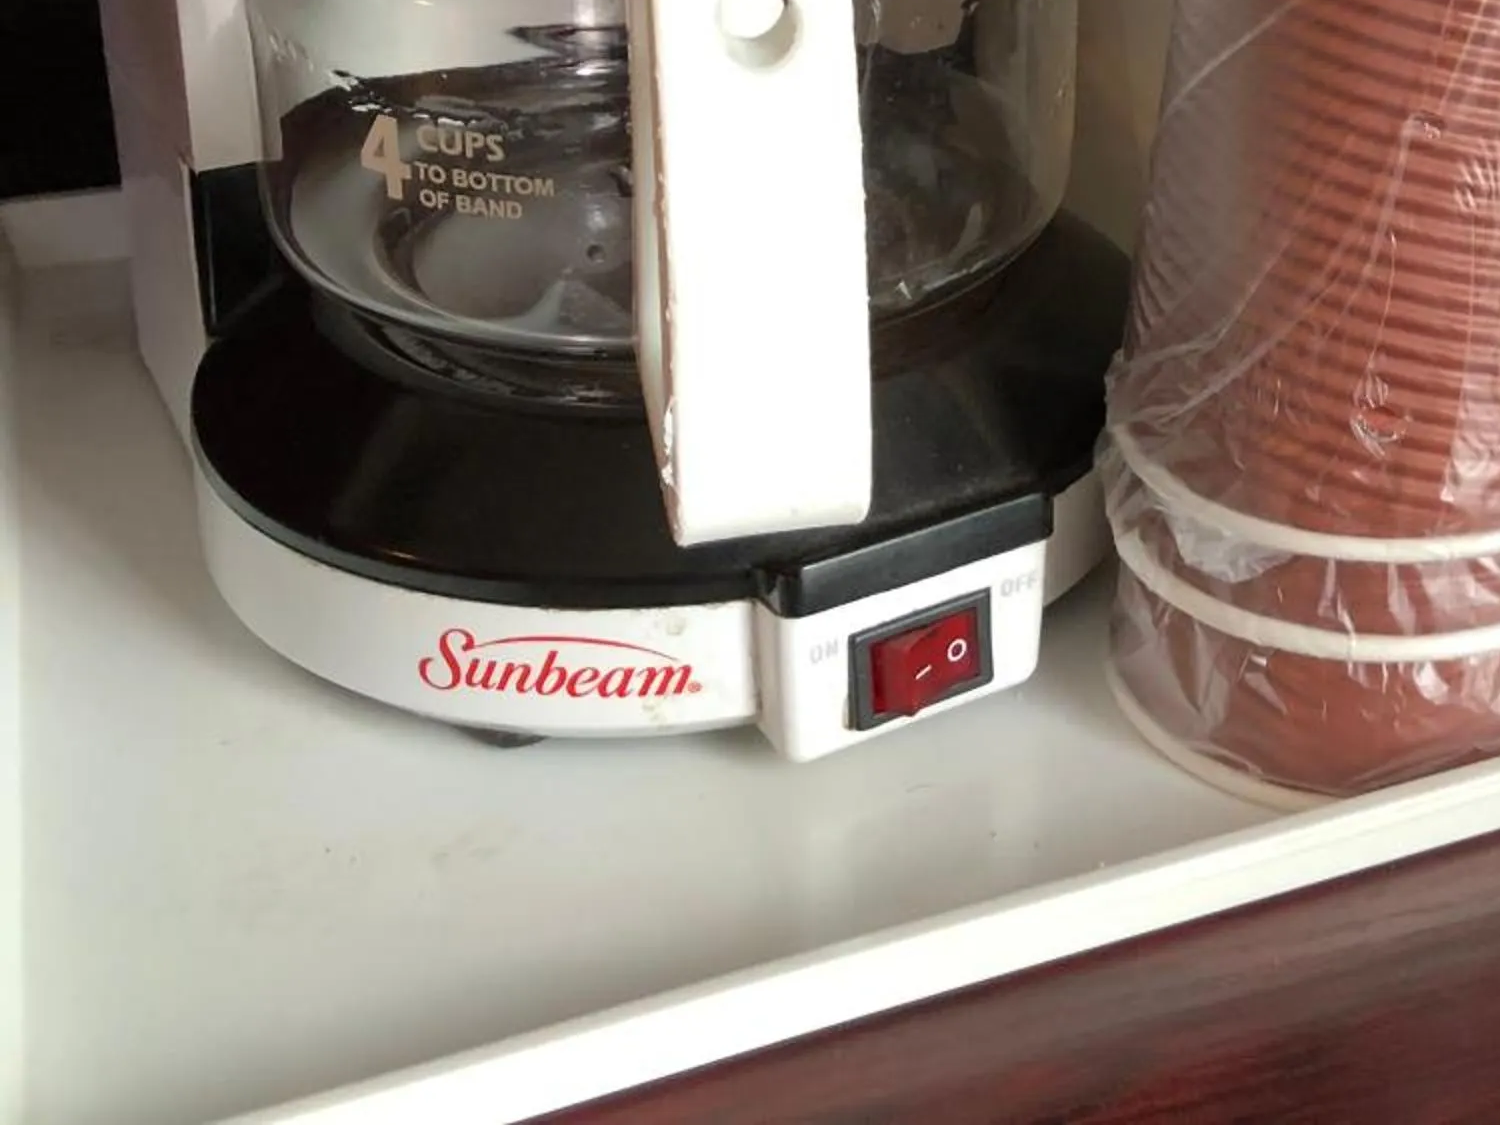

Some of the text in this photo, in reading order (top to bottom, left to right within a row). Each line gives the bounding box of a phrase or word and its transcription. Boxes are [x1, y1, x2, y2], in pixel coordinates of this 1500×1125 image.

[360, 114, 504, 200] 4 CUPS
[413, 161, 555, 197] TO BOTTOM
[419, 188, 523, 220] OF BAND
[1000, 570, 1037, 597] OFF
[418, 628, 693, 698] Sunbeam
[810, 639, 839, 664] ON
